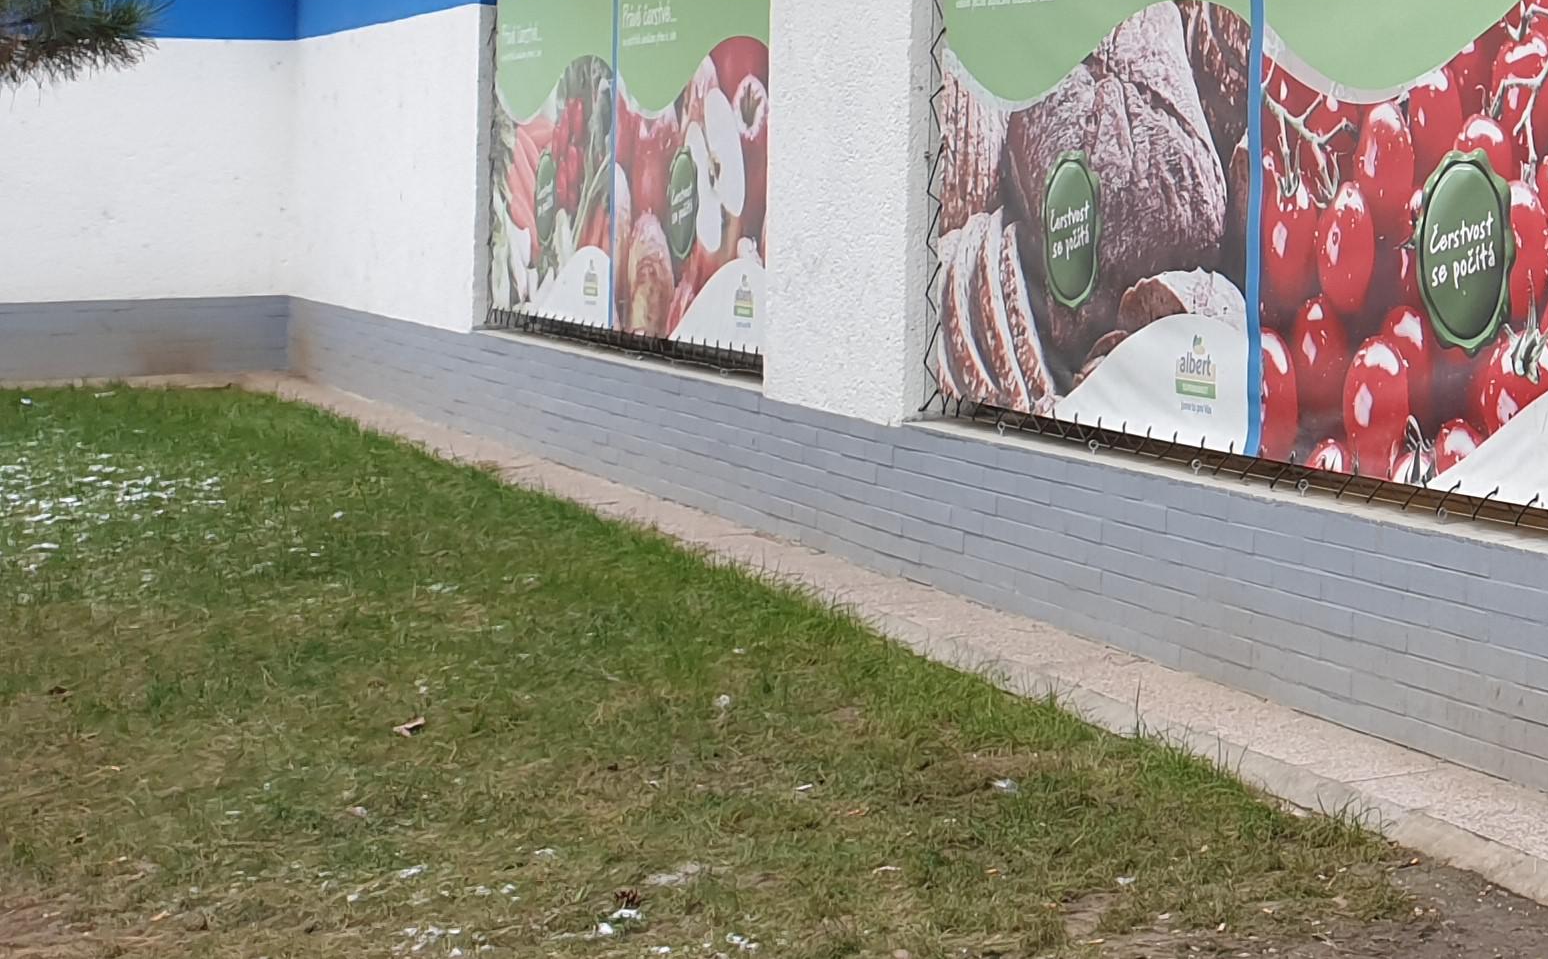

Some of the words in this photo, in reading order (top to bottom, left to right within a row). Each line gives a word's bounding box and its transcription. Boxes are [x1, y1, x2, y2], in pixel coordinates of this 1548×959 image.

[1429, 211, 1494, 254] Čerstvost
[1431, 263, 1447, 287] se
[1453, 241, 1496, 289] počítá
[1179, 351, 1211, 377] albert
